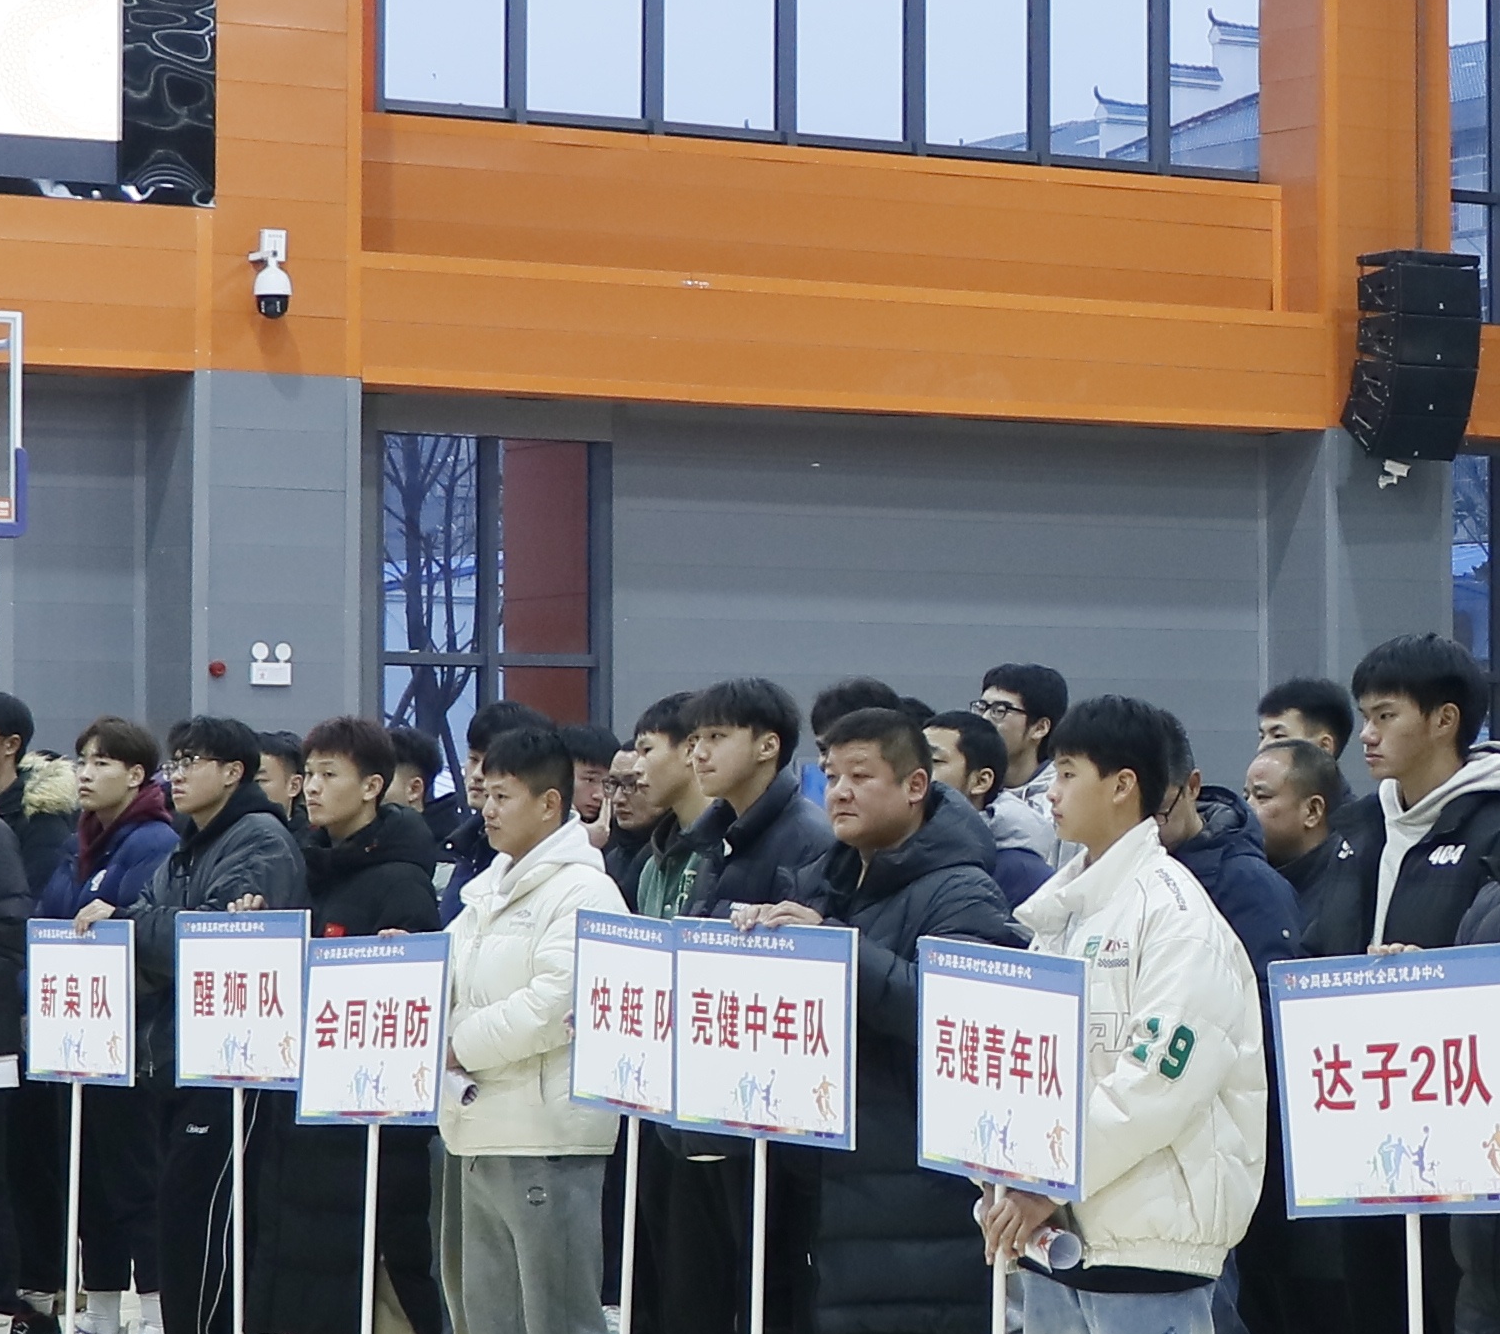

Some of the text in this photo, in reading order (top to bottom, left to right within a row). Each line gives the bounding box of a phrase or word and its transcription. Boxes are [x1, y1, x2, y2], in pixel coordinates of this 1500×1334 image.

[193, 970, 284, 1018] 醒狮队
[315, 996, 432, 1050] 会同消防
[590, 975, 673, 1043] 快艇队
[691, 987, 830, 1058] 亮健中年队
[935, 1014, 1063, 1100] 亮健青年队
[1311, 1033, 1493, 1113] 达子2队
